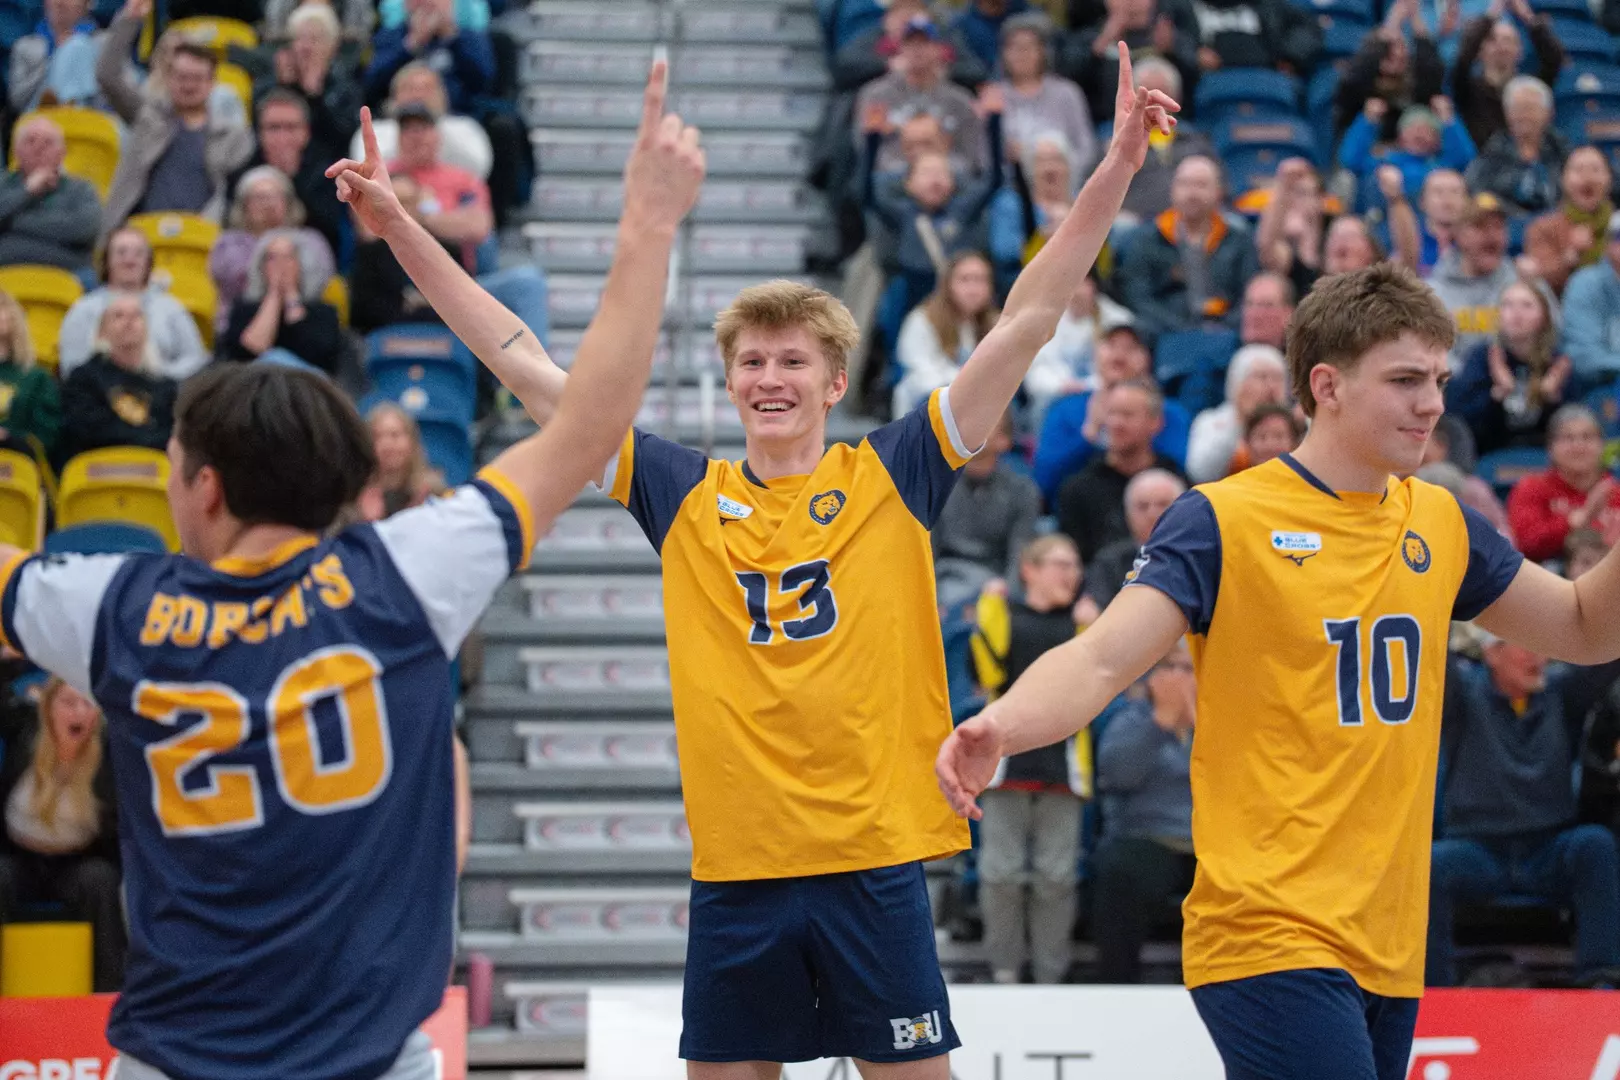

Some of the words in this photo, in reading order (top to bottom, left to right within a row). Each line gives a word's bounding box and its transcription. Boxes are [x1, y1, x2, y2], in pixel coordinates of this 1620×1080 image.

[734, 558, 839, 646] 13
[1322, 613, 1422, 727] 10
[131, 643, 394, 838] 20
